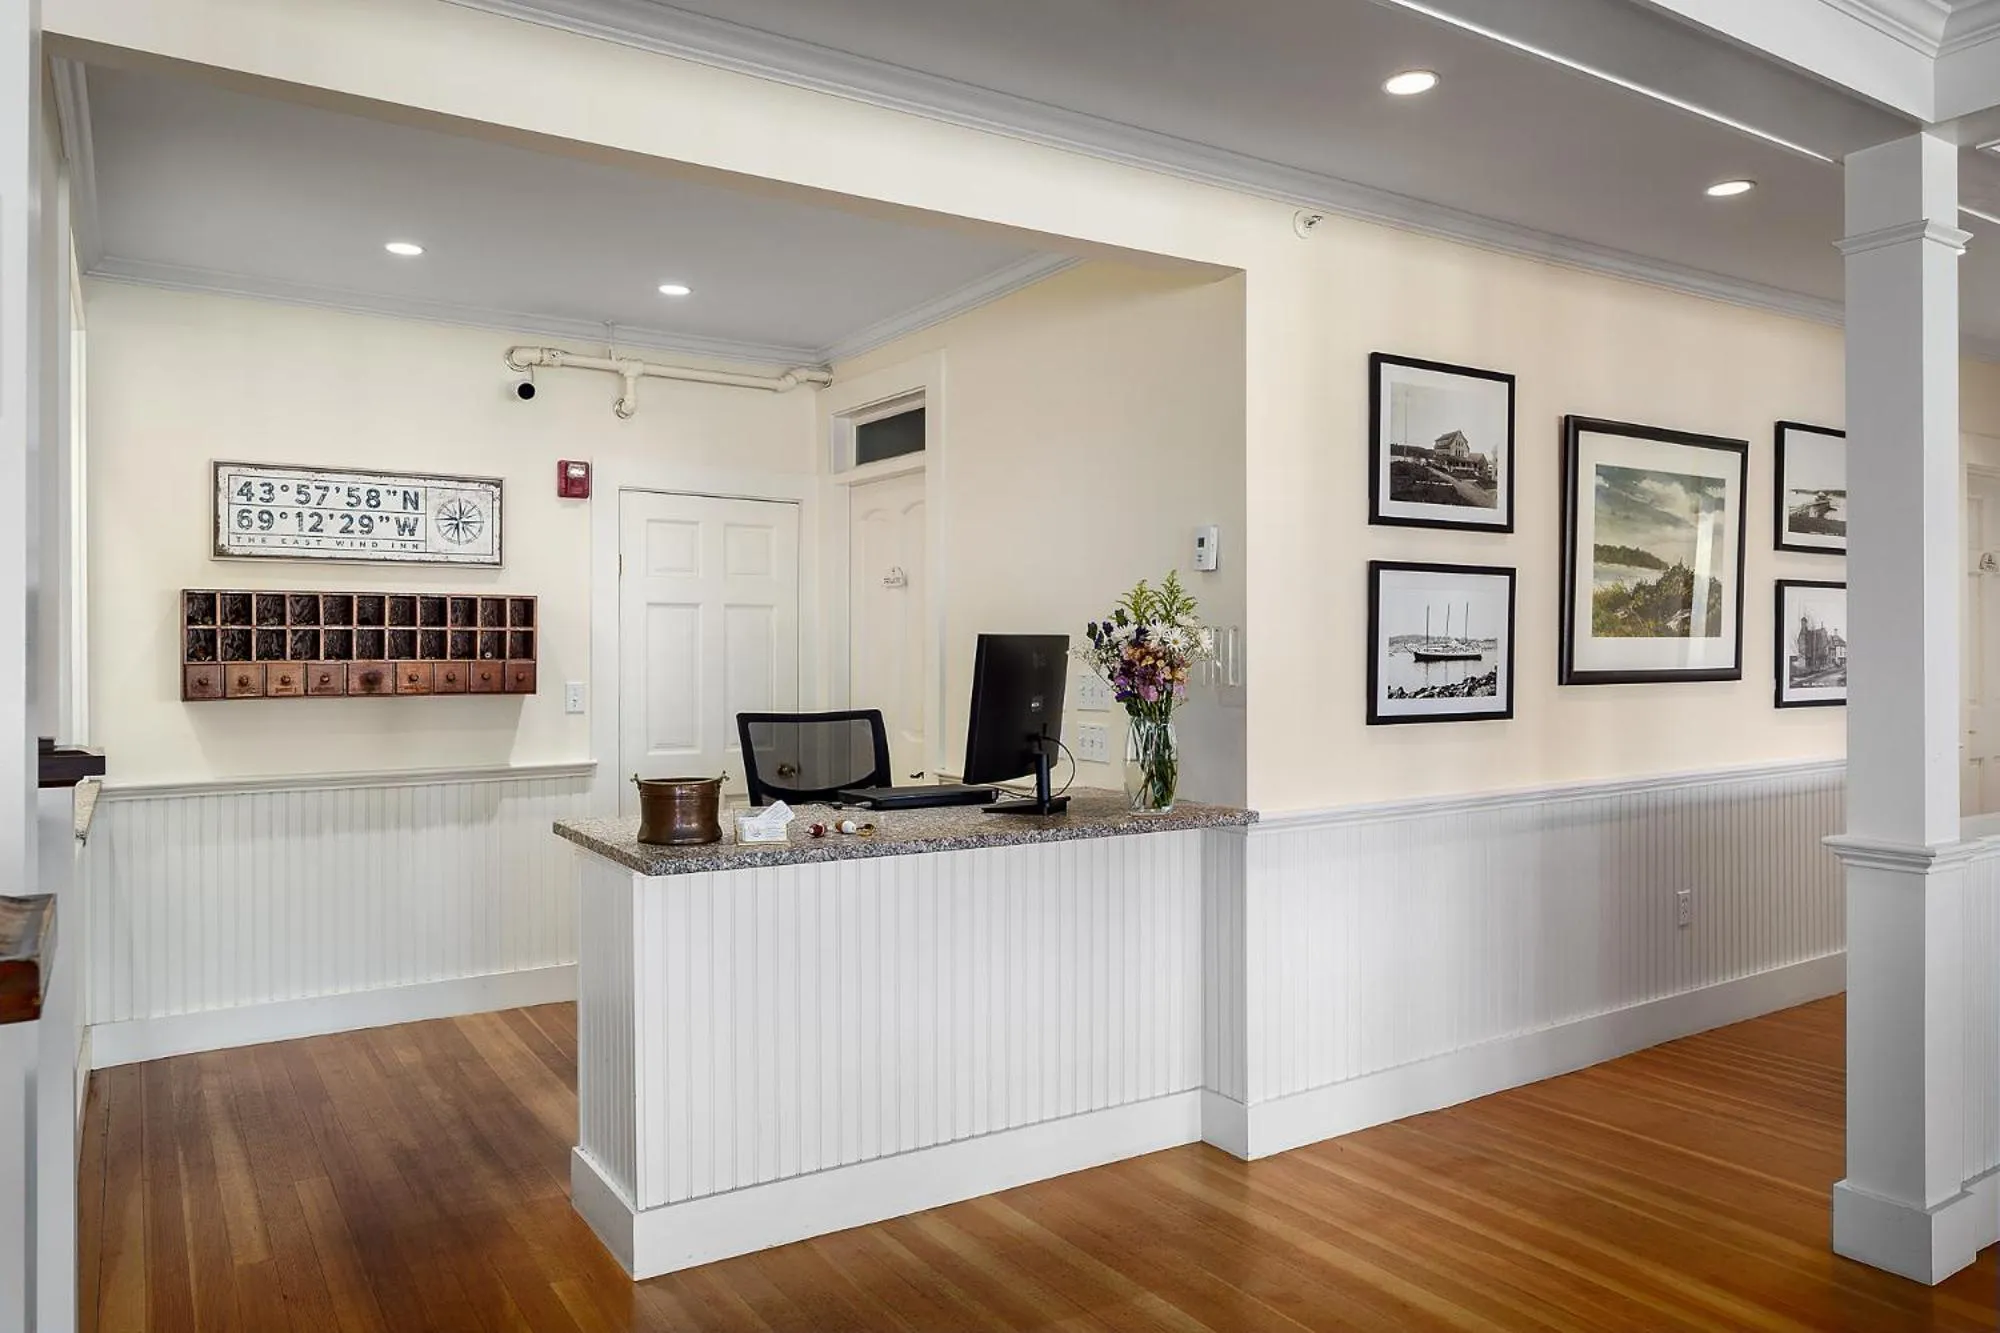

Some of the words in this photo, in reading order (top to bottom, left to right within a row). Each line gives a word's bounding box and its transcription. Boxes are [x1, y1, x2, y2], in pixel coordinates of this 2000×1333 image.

[236, 536, 267, 544] THE
[280, 538, 322, 546] EAST
[335, 540, 378, 548] WIND
